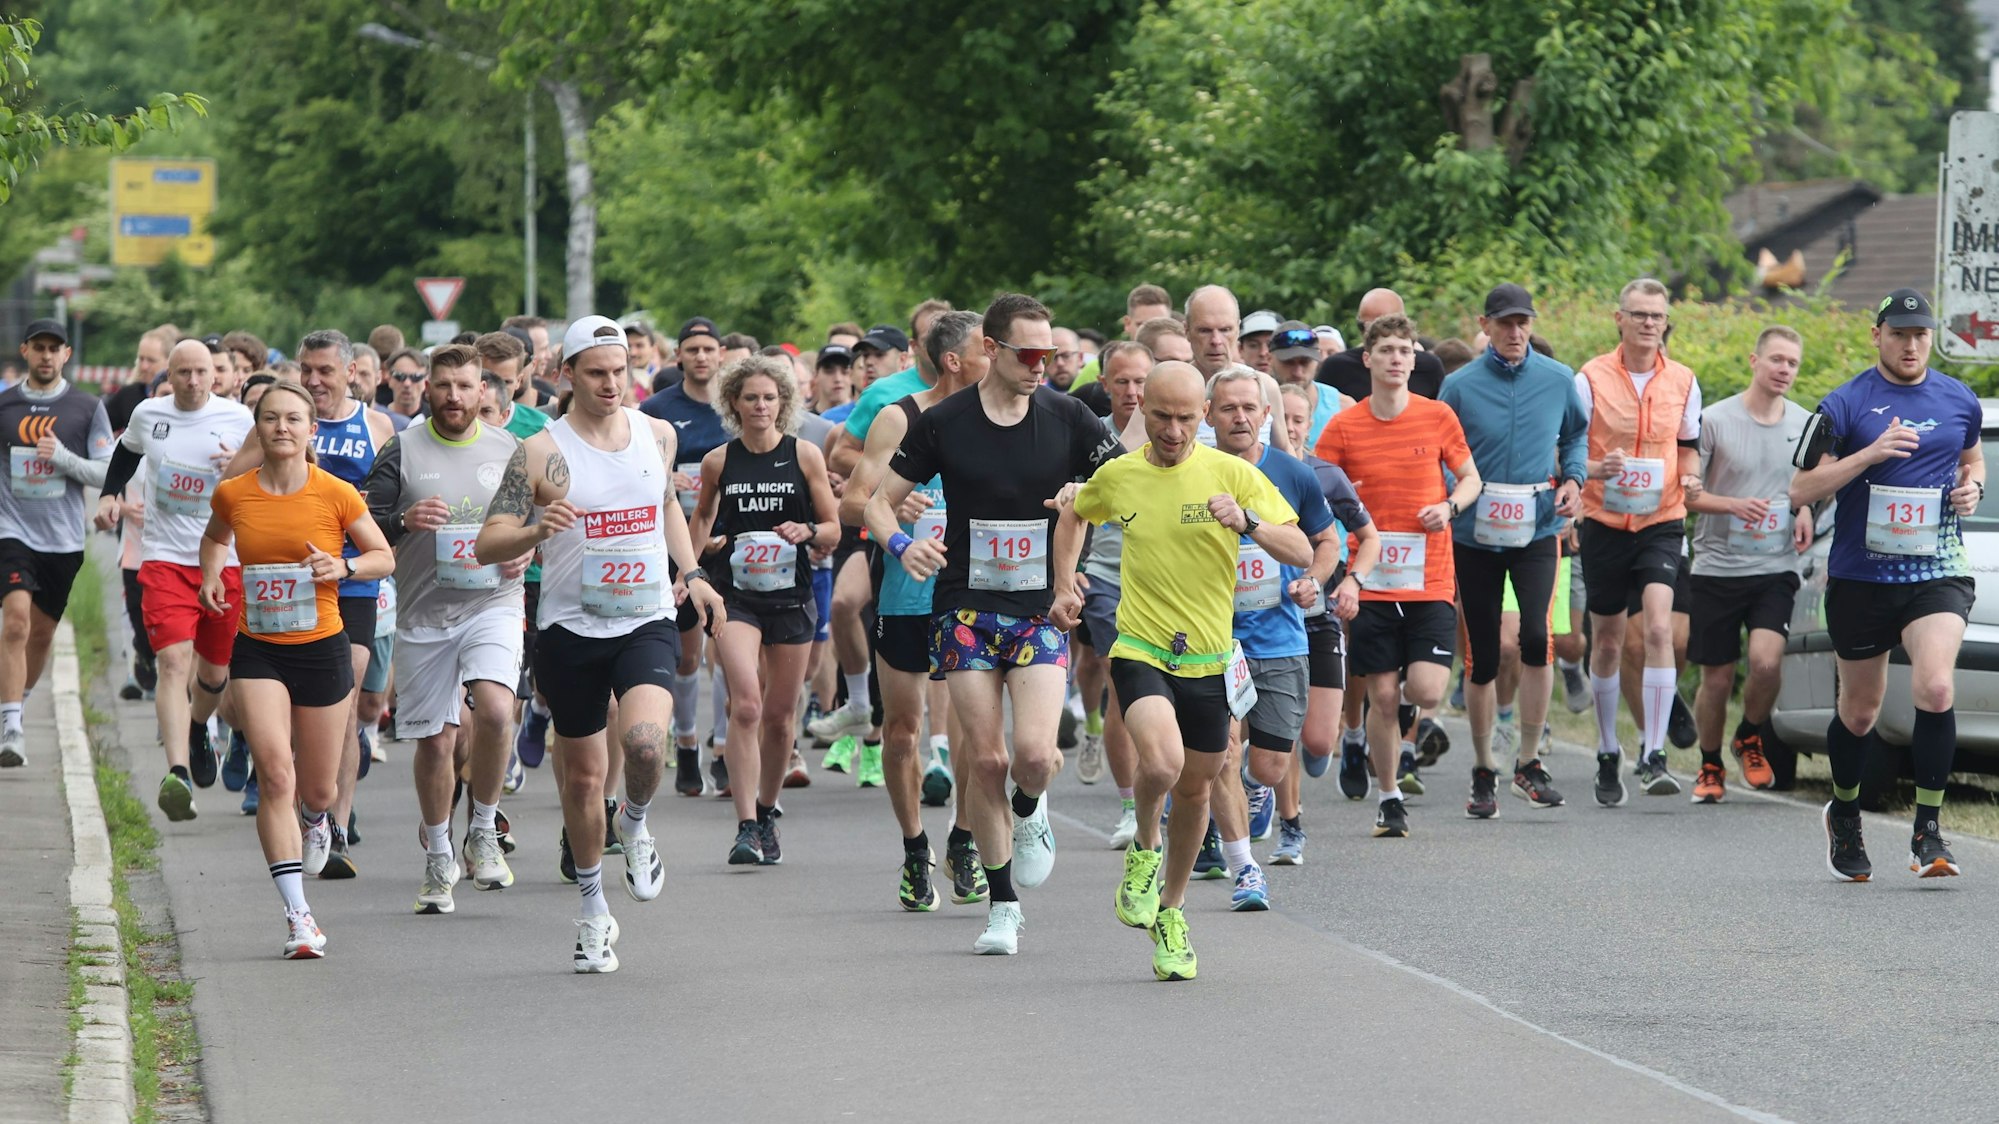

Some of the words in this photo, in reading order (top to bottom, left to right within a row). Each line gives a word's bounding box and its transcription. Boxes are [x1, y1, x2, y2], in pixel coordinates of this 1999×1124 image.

[170, 473, 204, 494] 309
[419, 472, 440, 480] JAKO
[1616, 470, 1651, 488] 229
[725, 483, 754, 495] HEUL
[738, 497, 783, 512] LAUF!
[1489, 501, 1524, 520] 208
[1887, 502, 1925, 524] 131
[587, 514, 602, 529] M
[606, 508, 649, 523] MILERS
[606, 520, 655, 535] COLONIA
[744, 545, 782, 563] 227
[988, 536, 1031, 558] 119
[1379, 545, 1411, 564] 197
[601, 561, 646, 583] 222
[998, 563, 1019, 571] Marc
[256, 579, 297, 601] 257
[612, 588, 634, 596] Felix
[1234, 584, 1260, 592] ohann
[1233, 659, 1248, 688] 30
